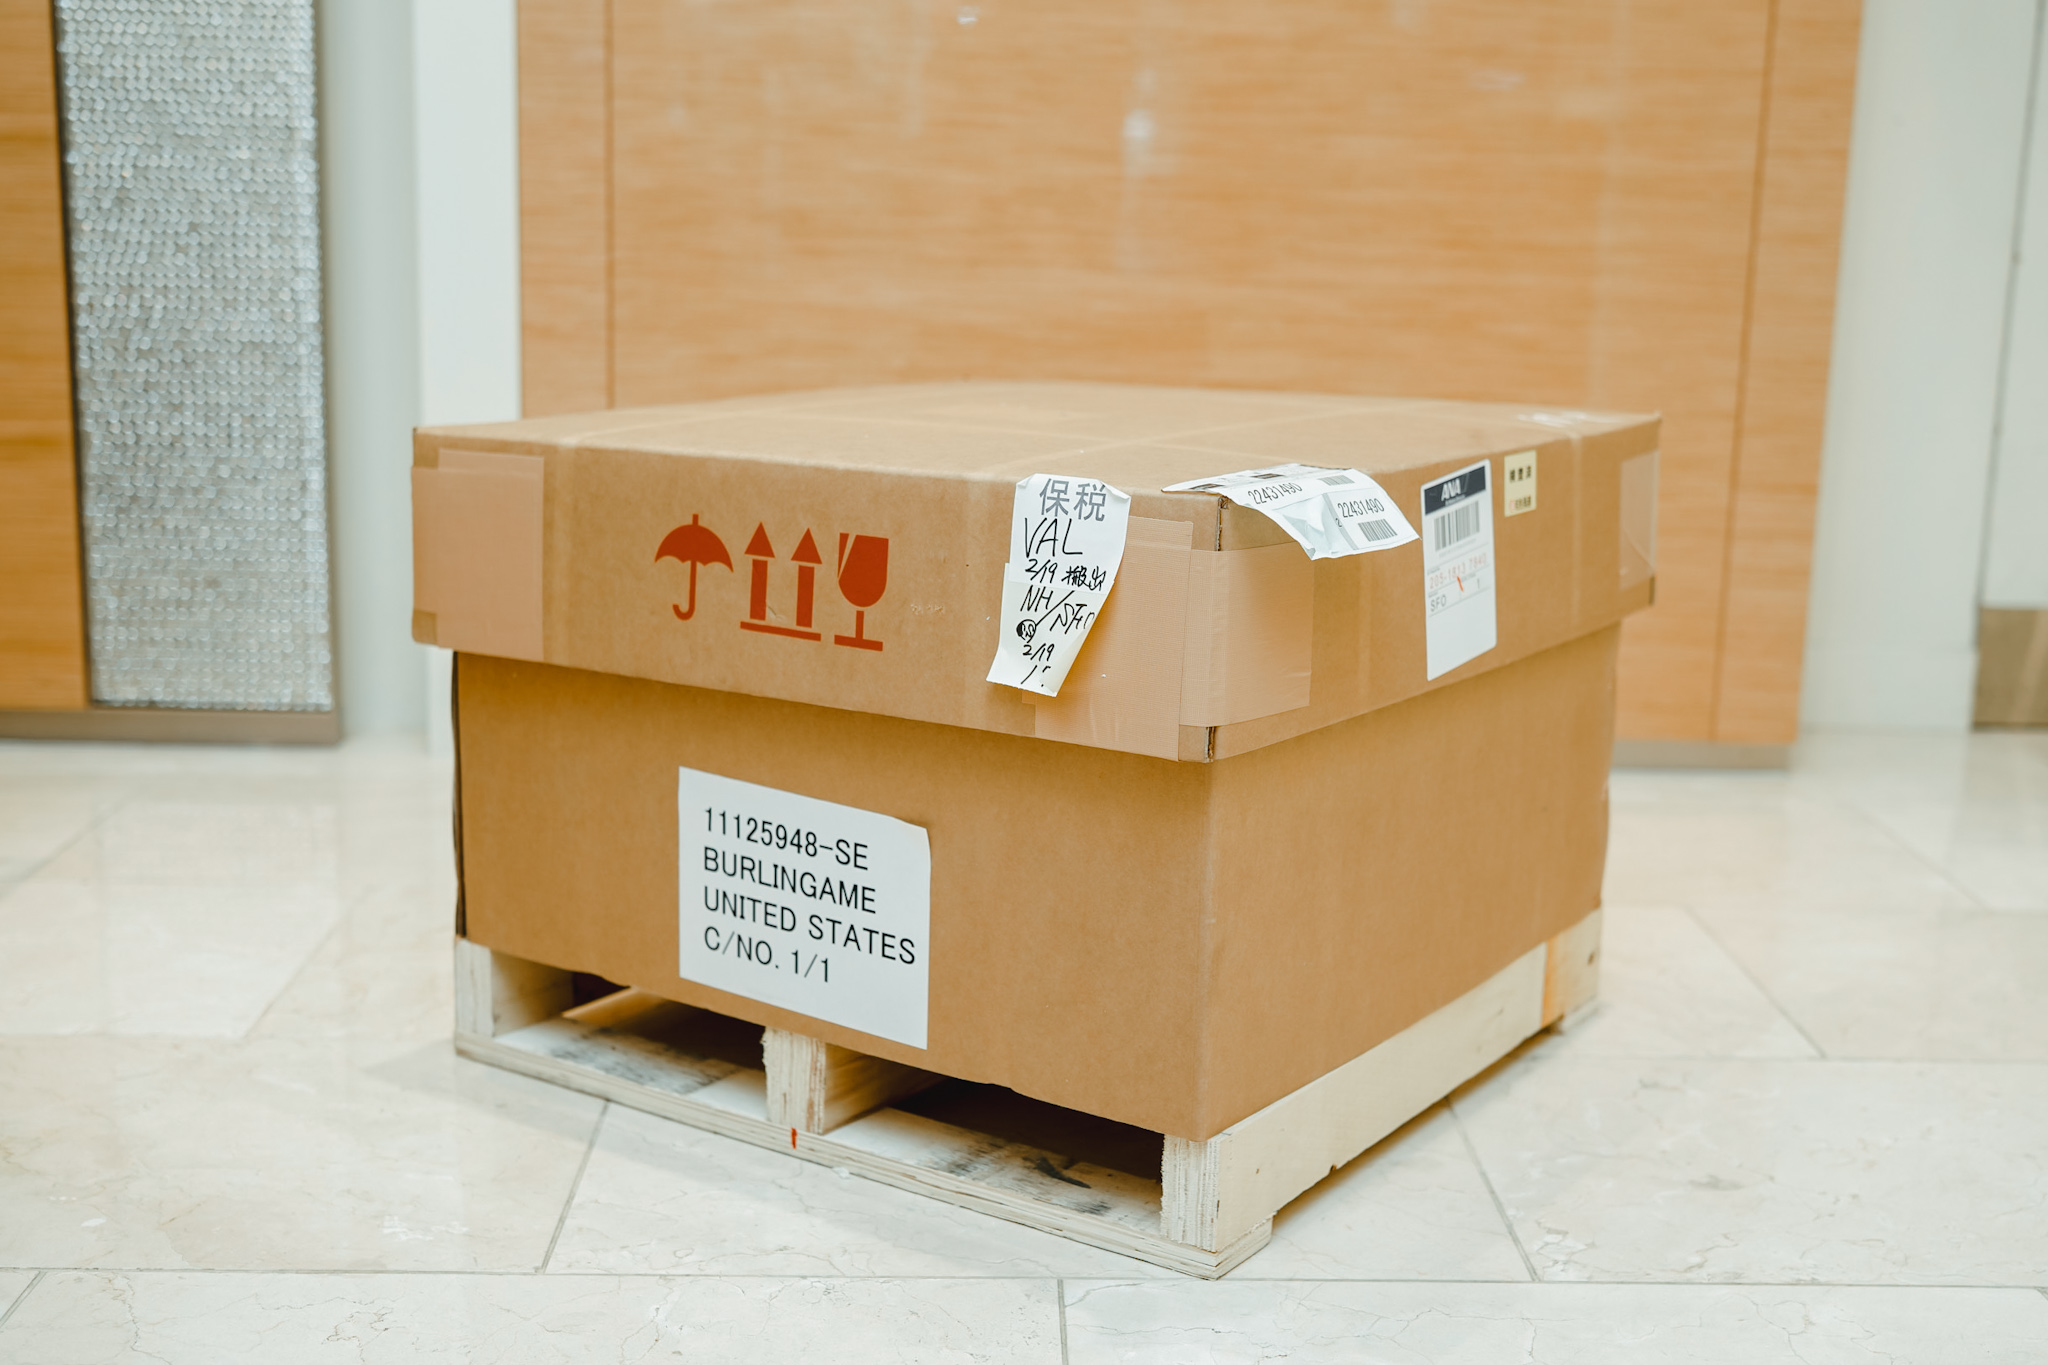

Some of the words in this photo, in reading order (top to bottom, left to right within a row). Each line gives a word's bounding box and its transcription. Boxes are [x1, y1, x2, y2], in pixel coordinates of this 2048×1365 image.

[1039, 478, 1107, 522] 保税
[1247, 482, 1303, 505] 22431490
[1441, 478, 1462, 502] ANA
[1337, 497, 1385, 518] 22431490
[1024, 517, 1083, 558] VAL
[1025, 559, 1058, 584] 2/19
[1430, 594, 1447, 612] SFO
[1022, 642, 1056, 662] 2/19
[704, 806, 869, 871] 11125948-SE
[704, 846, 876, 914] BURLINGAME
[704, 885, 797, 932] UNITED
[808, 914, 916, 965] STATES
[704, 926, 779, 969] C/NO.
[791, 949, 829, 983] 1/1
